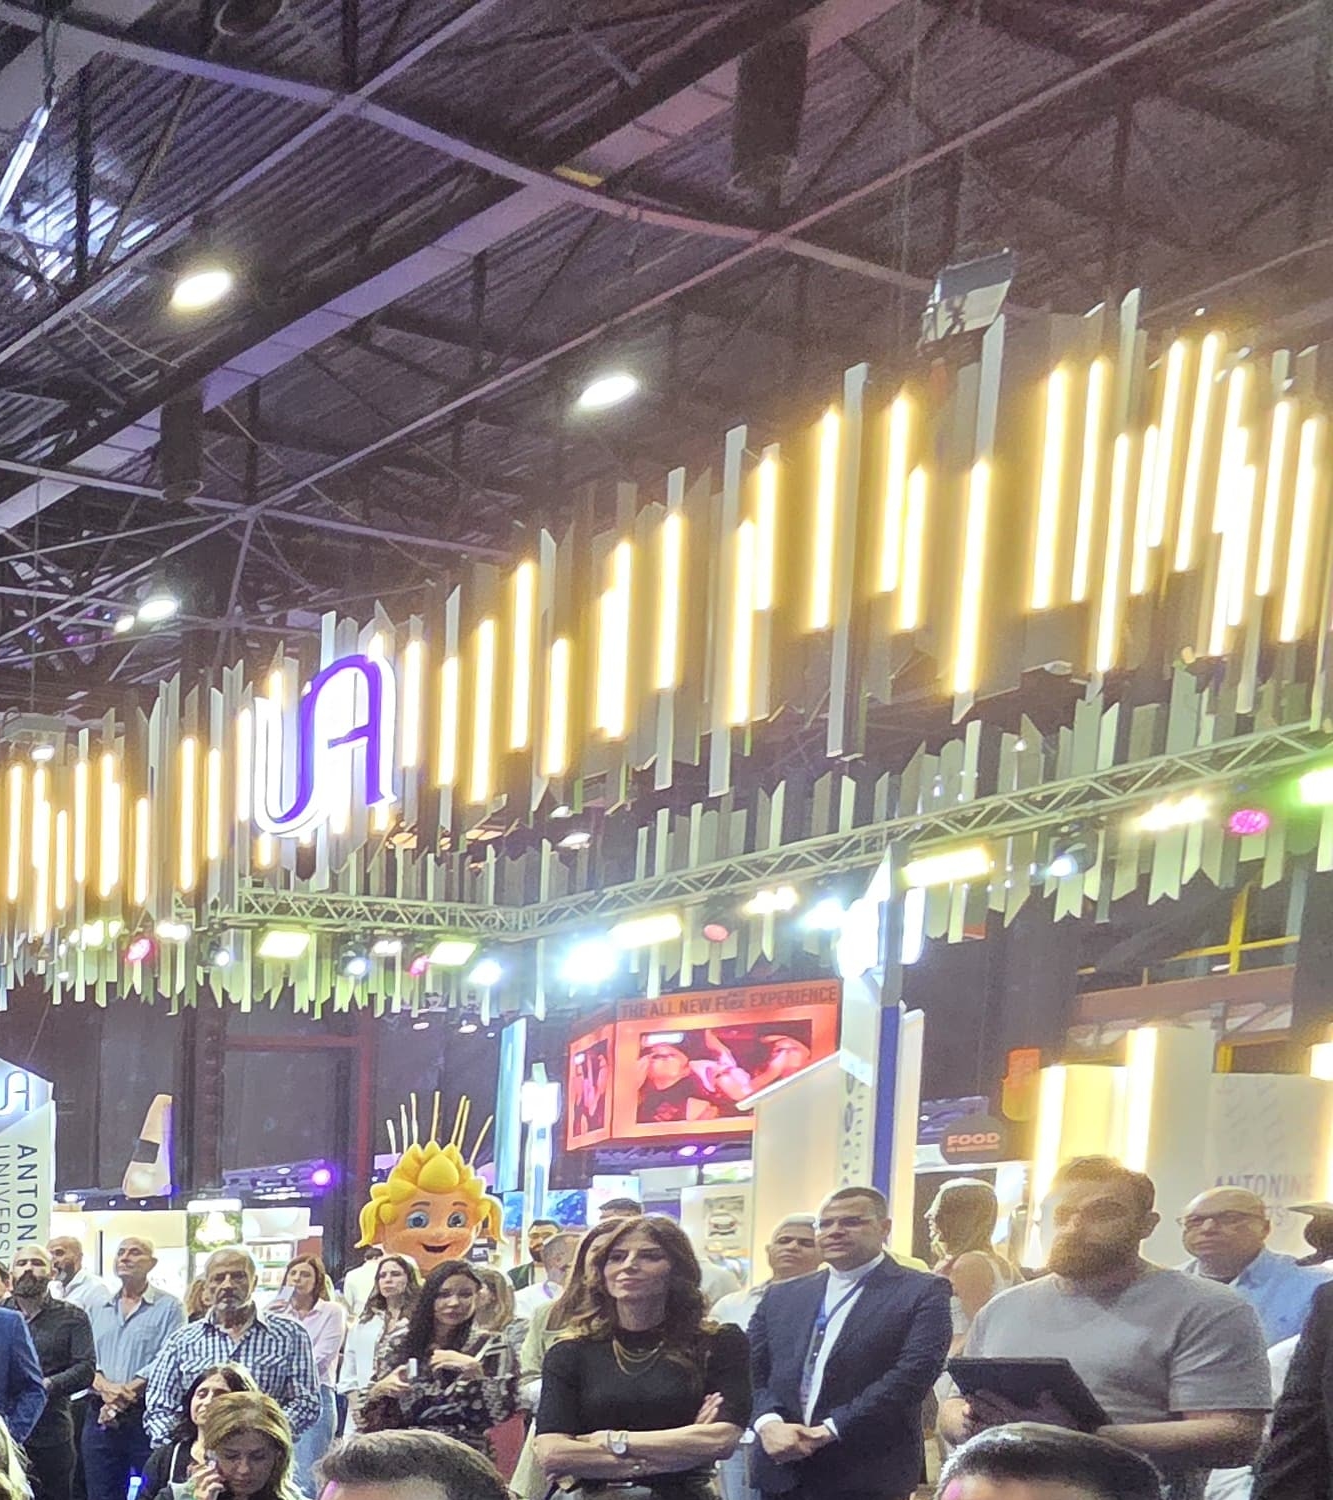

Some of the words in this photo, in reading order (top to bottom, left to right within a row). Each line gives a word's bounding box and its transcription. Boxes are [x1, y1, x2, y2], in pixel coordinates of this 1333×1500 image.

[650, 1001, 676, 1017] ALL
[679, 998, 711, 1014] NEW
[749, 986, 837, 1008] EXPERIENCE
[947, 1132, 1000, 1146] FOOD
[17, 1144, 38, 1250] ANTON
